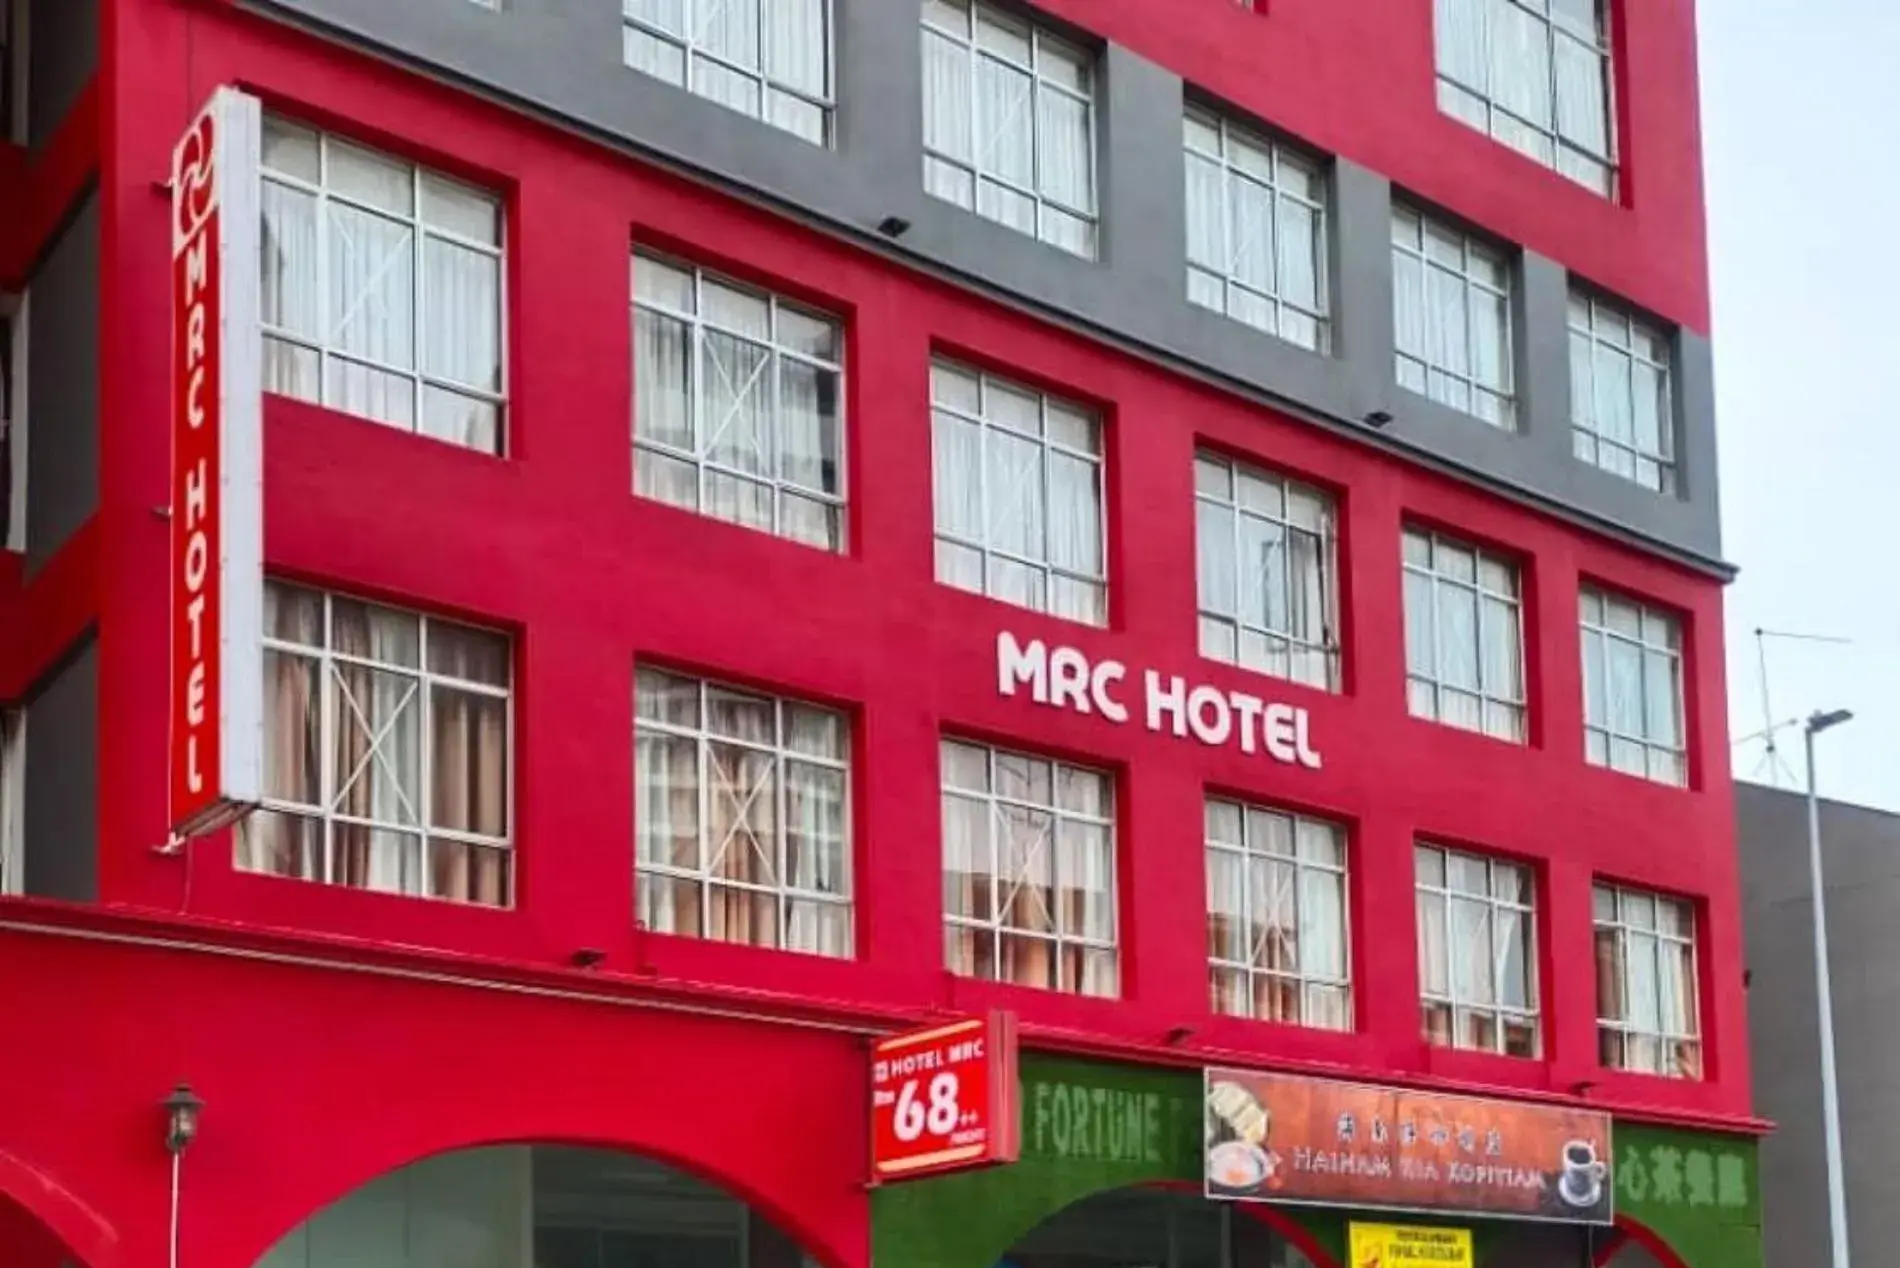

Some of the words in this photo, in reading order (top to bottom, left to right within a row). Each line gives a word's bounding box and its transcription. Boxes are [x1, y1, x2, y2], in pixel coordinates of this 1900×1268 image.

[186, 228, 208, 429] MRC
[185, 458, 208, 794] HOTEL
[997, 631, 1129, 723] MRC
[1144, 669, 1323, 769] HOTEL
[890, 1048, 943, 1078] HOTEL
[947, 1037, 985, 1063] MRC
[1034, 1081, 1161, 1162] FORTUNE
